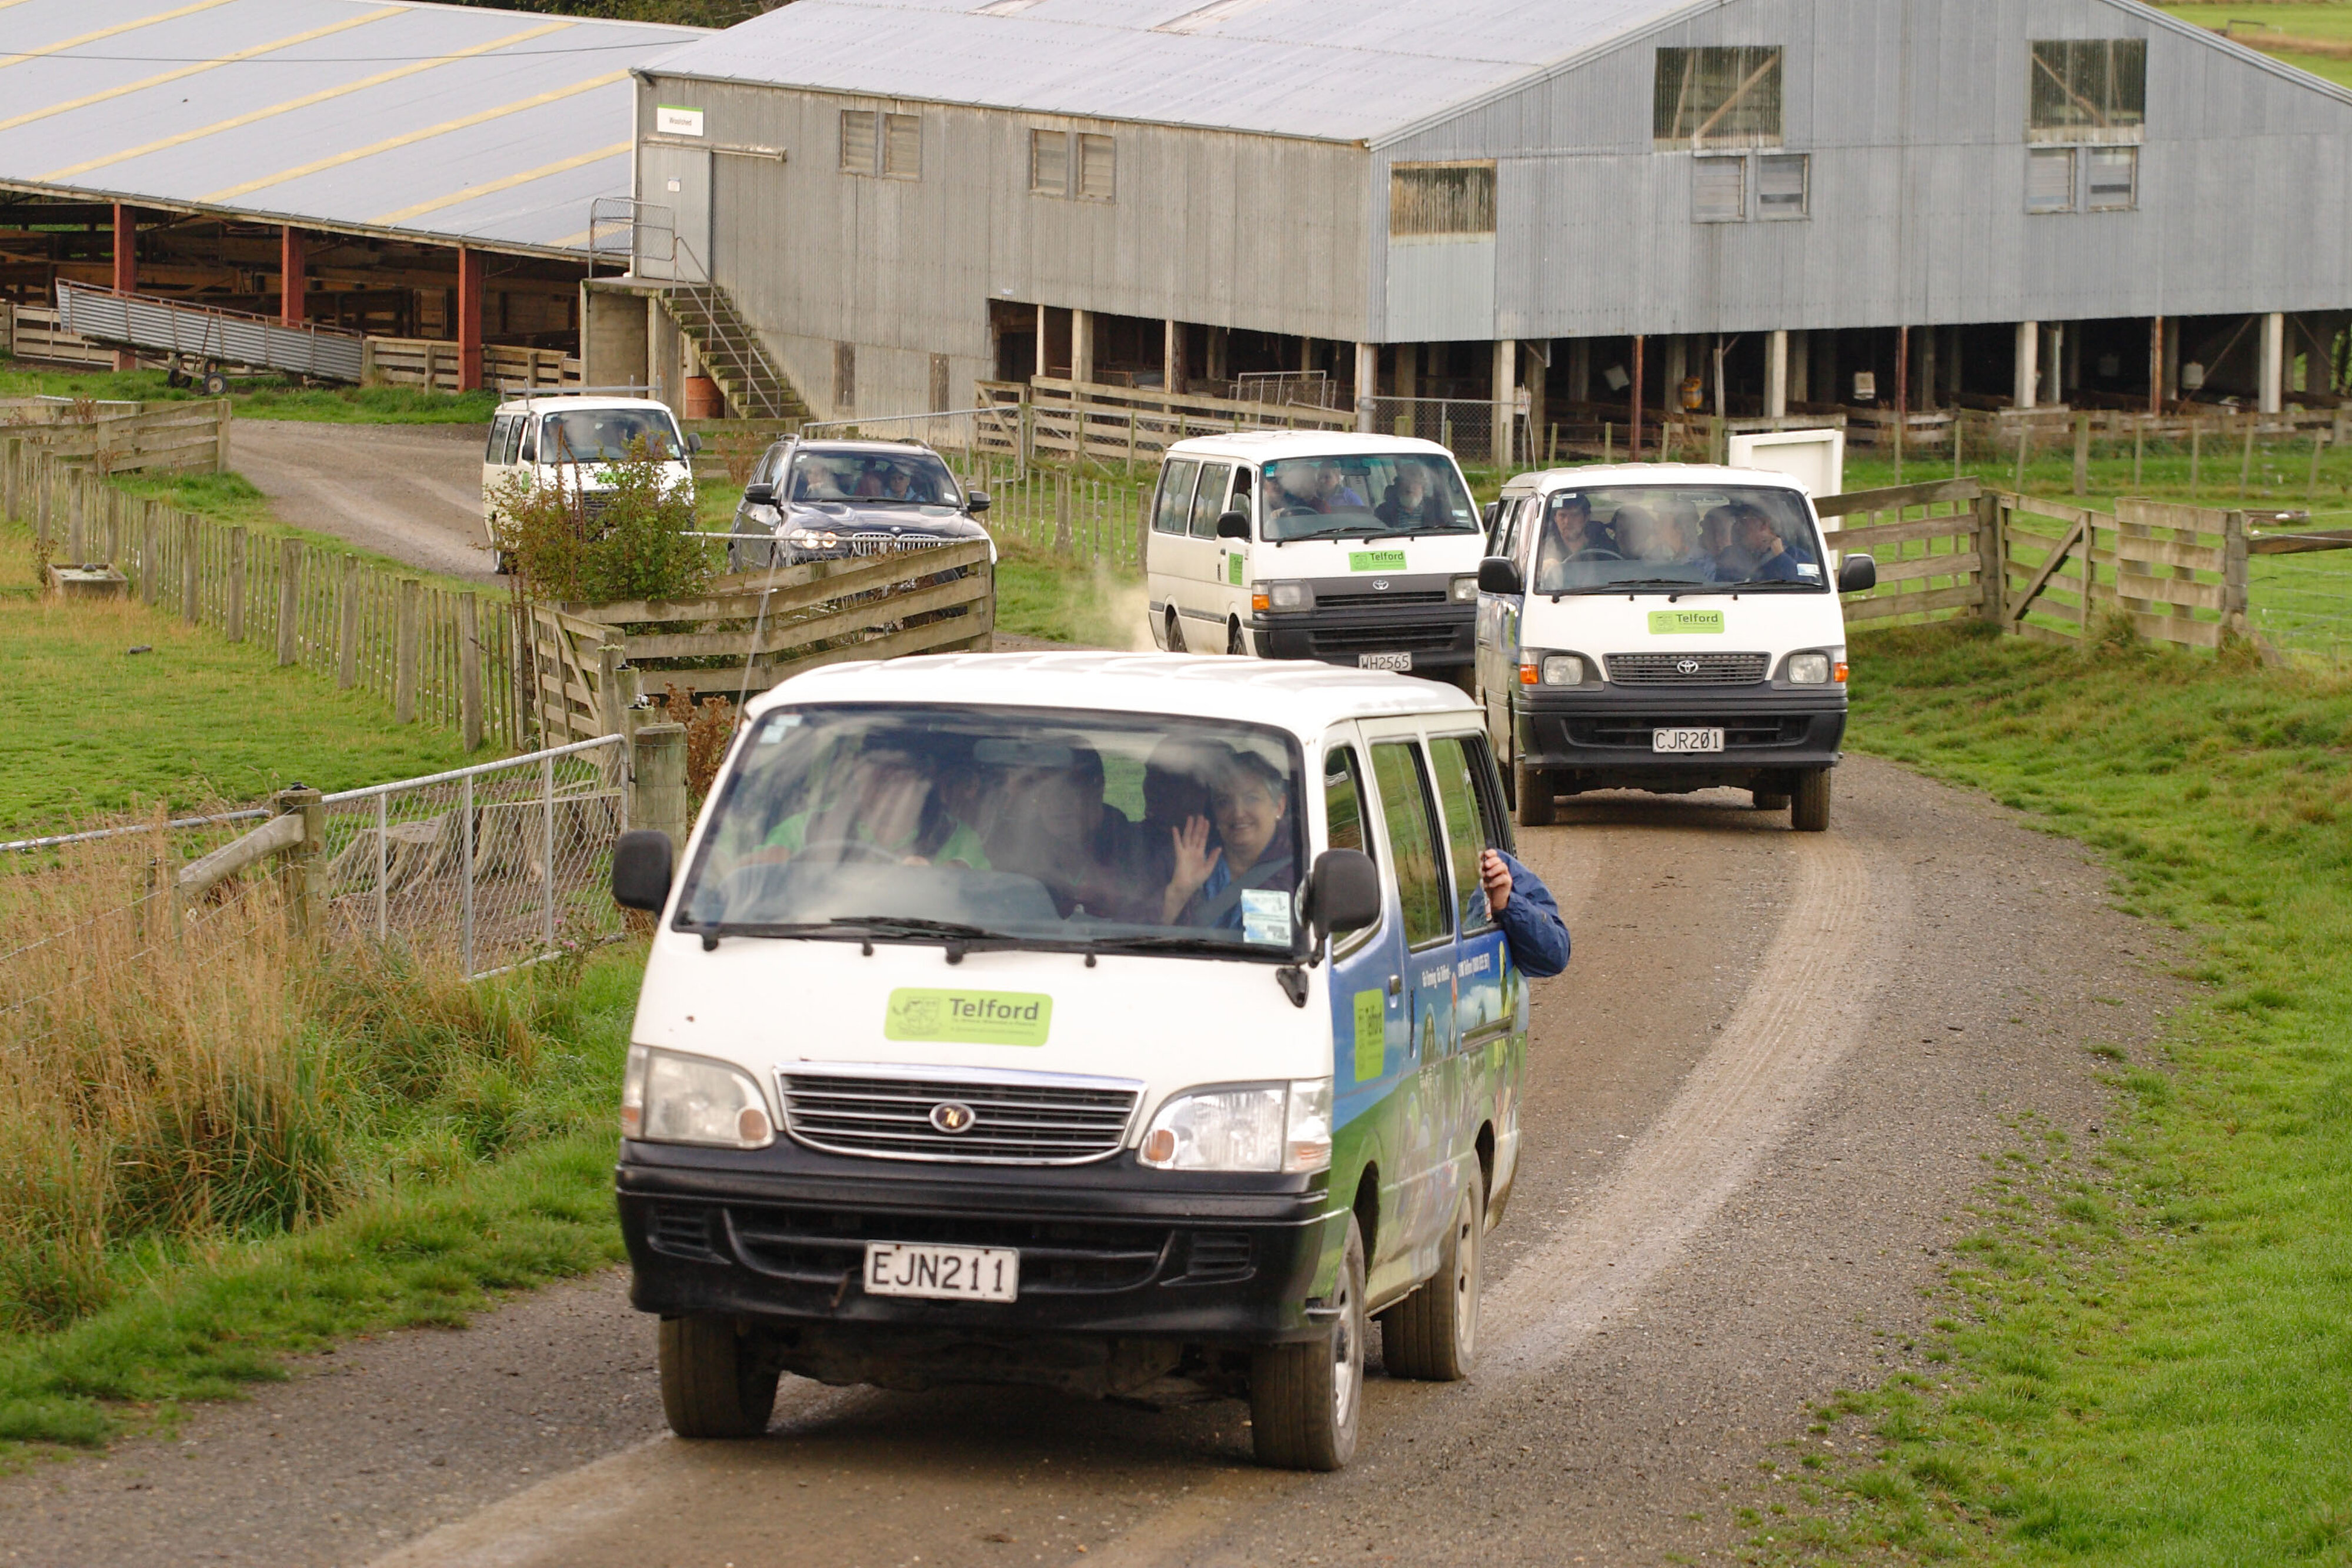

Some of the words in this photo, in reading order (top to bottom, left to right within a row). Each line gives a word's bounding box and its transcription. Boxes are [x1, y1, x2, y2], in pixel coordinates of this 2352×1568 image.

[1370, 552, 1403, 561] Telford
[1676, 613, 1718, 623] Telford
[1361, 655, 1409, 669] WH2565
[1656, 732, 1719, 749] CJR201
[949, 997, 1039, 1020] Telford
[872, 1251, 1003, 1292] EJN211
